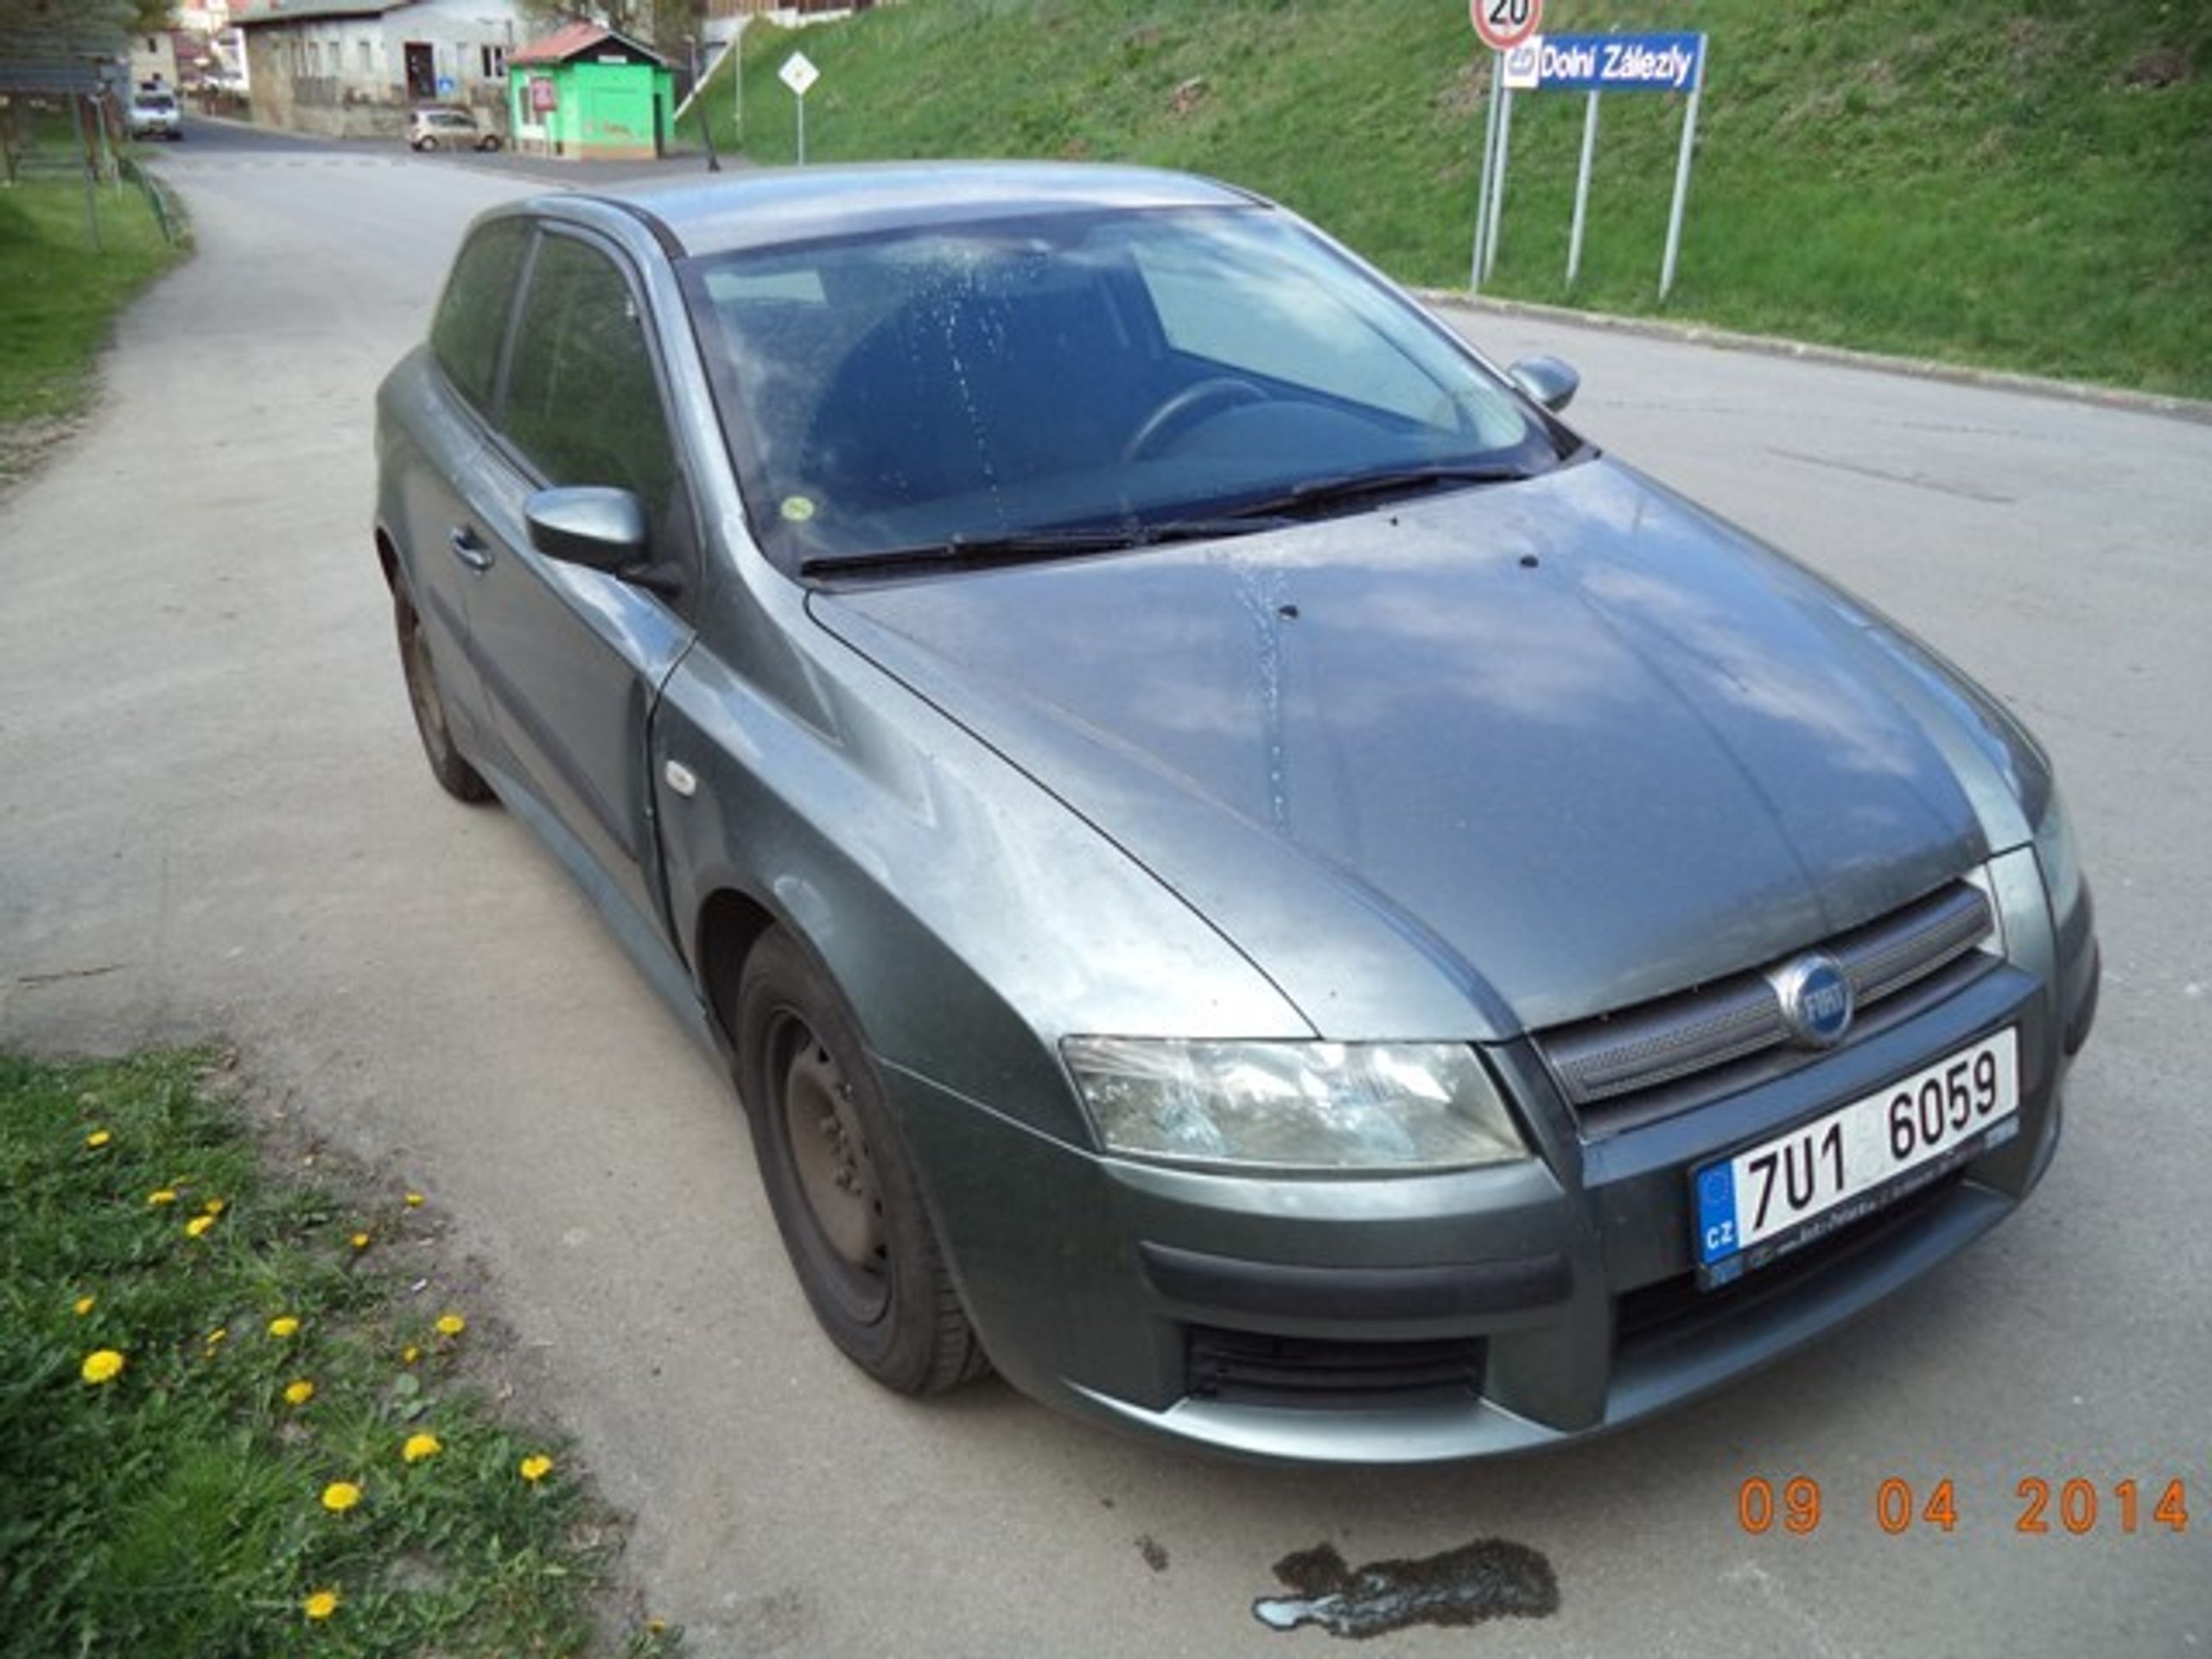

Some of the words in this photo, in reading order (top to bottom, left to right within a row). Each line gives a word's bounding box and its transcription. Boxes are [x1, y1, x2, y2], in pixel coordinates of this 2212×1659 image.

[1541, 44, 1597, 78] Dolní
[1602, 42, 1694, 87] Zálezly
[1748, 1122, 1844, 1231] 7U1
[1888, 1050, 1997, 1160] 6059
[1706, 1223, 1734, 1249] CZ
